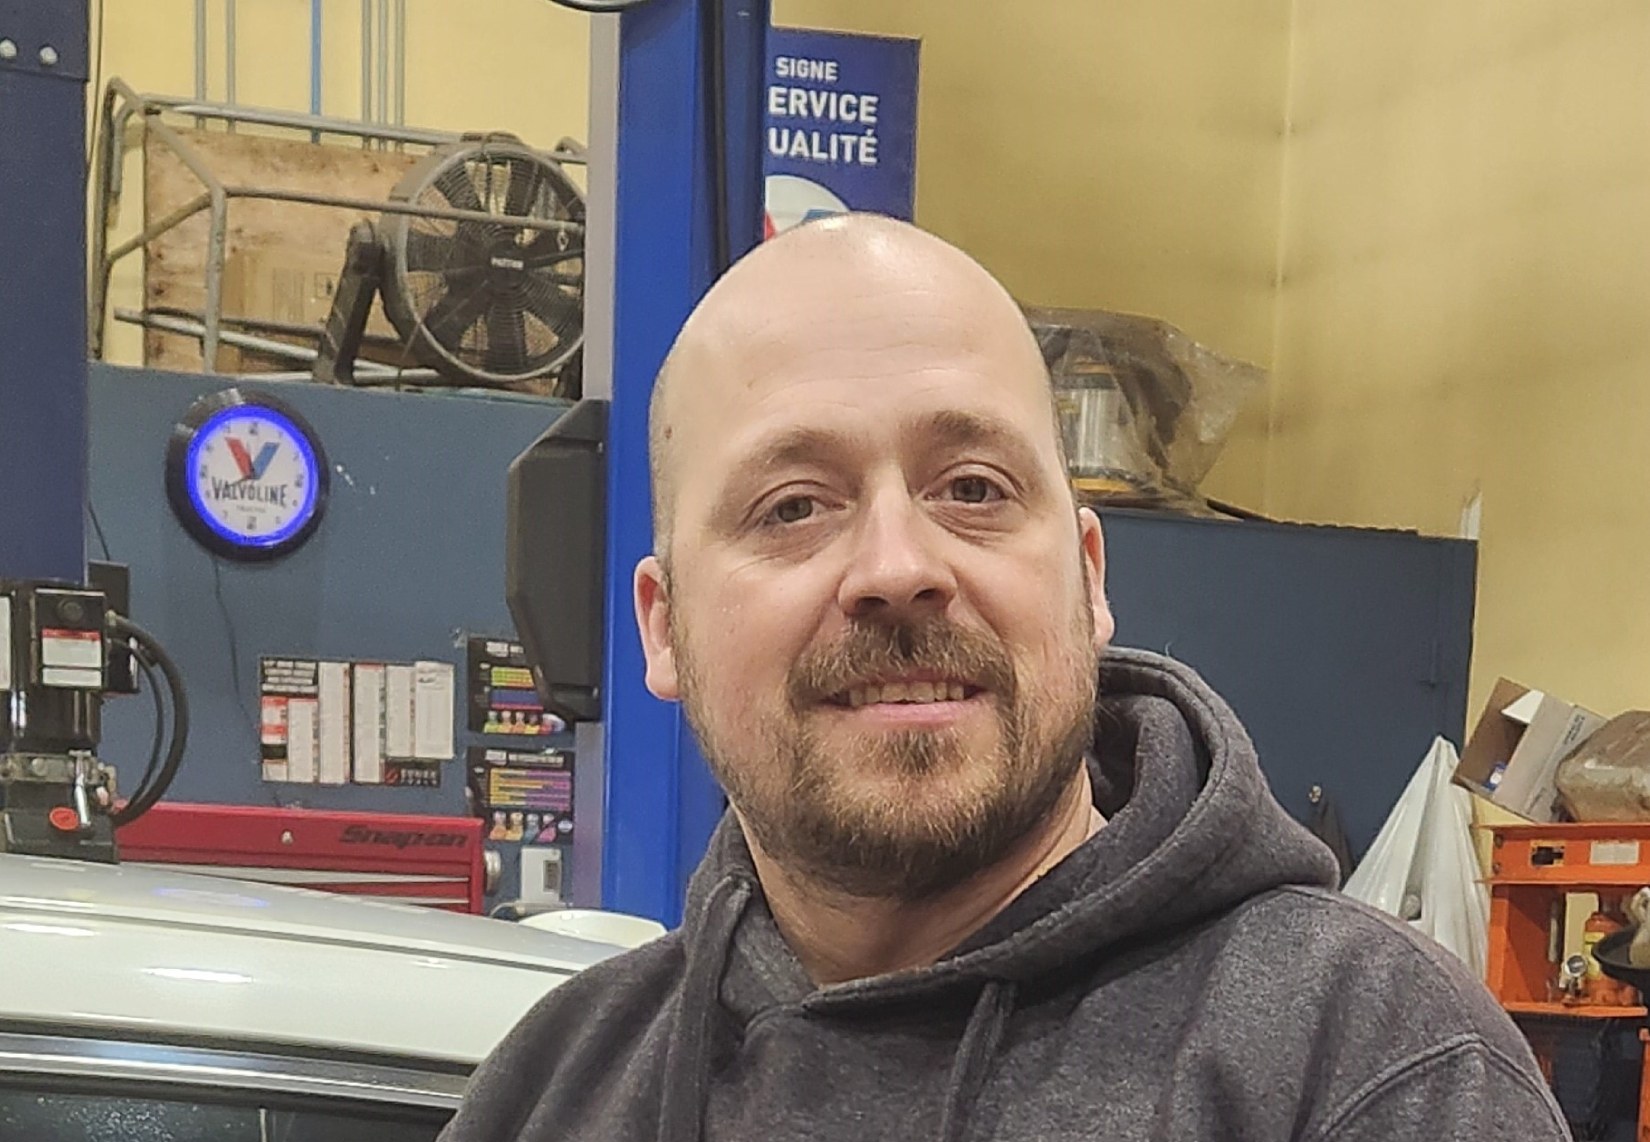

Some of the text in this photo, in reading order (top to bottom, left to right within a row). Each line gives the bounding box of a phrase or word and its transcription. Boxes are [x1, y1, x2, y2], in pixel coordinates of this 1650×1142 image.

[775, 57, 838, 82] SIGNE
[768, 86, 879, 123] ERVICE
[768, 127, 878, 164] UALITÉ
[212, 476, 289, 508] VALVOLINE
